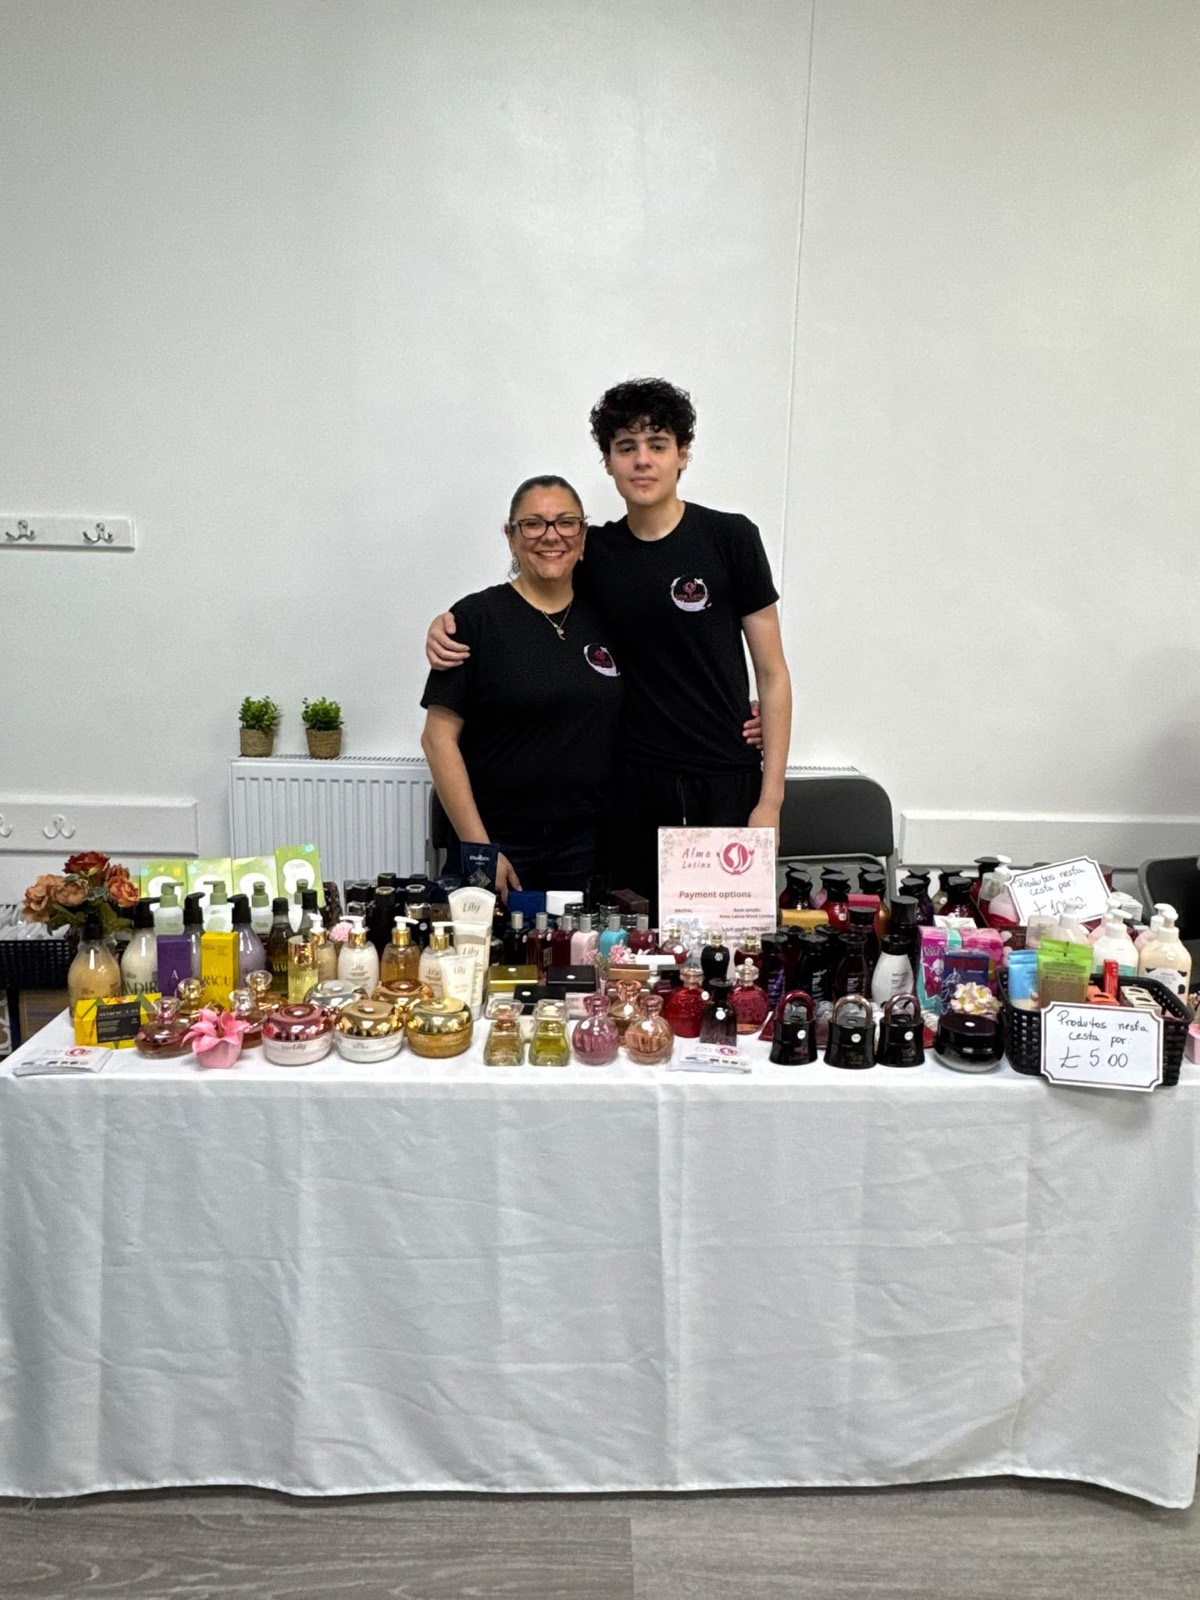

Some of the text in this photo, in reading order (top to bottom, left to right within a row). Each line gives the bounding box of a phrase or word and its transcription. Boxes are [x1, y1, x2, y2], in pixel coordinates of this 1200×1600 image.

[682, 848, 711, 859] Alma
[1017, 866, 1086, 888] Produtos nesta
[679, 891, 752, 900] Payment options
[1030, 884, 1054, 896] cesta
[462, 902, 481, 913] Lily
[462, 947, 480, 957] Lily
[1057, 1010, 1149, 1032] Produtos nesta
[1068, 1031, 1100, 1041] cesta
